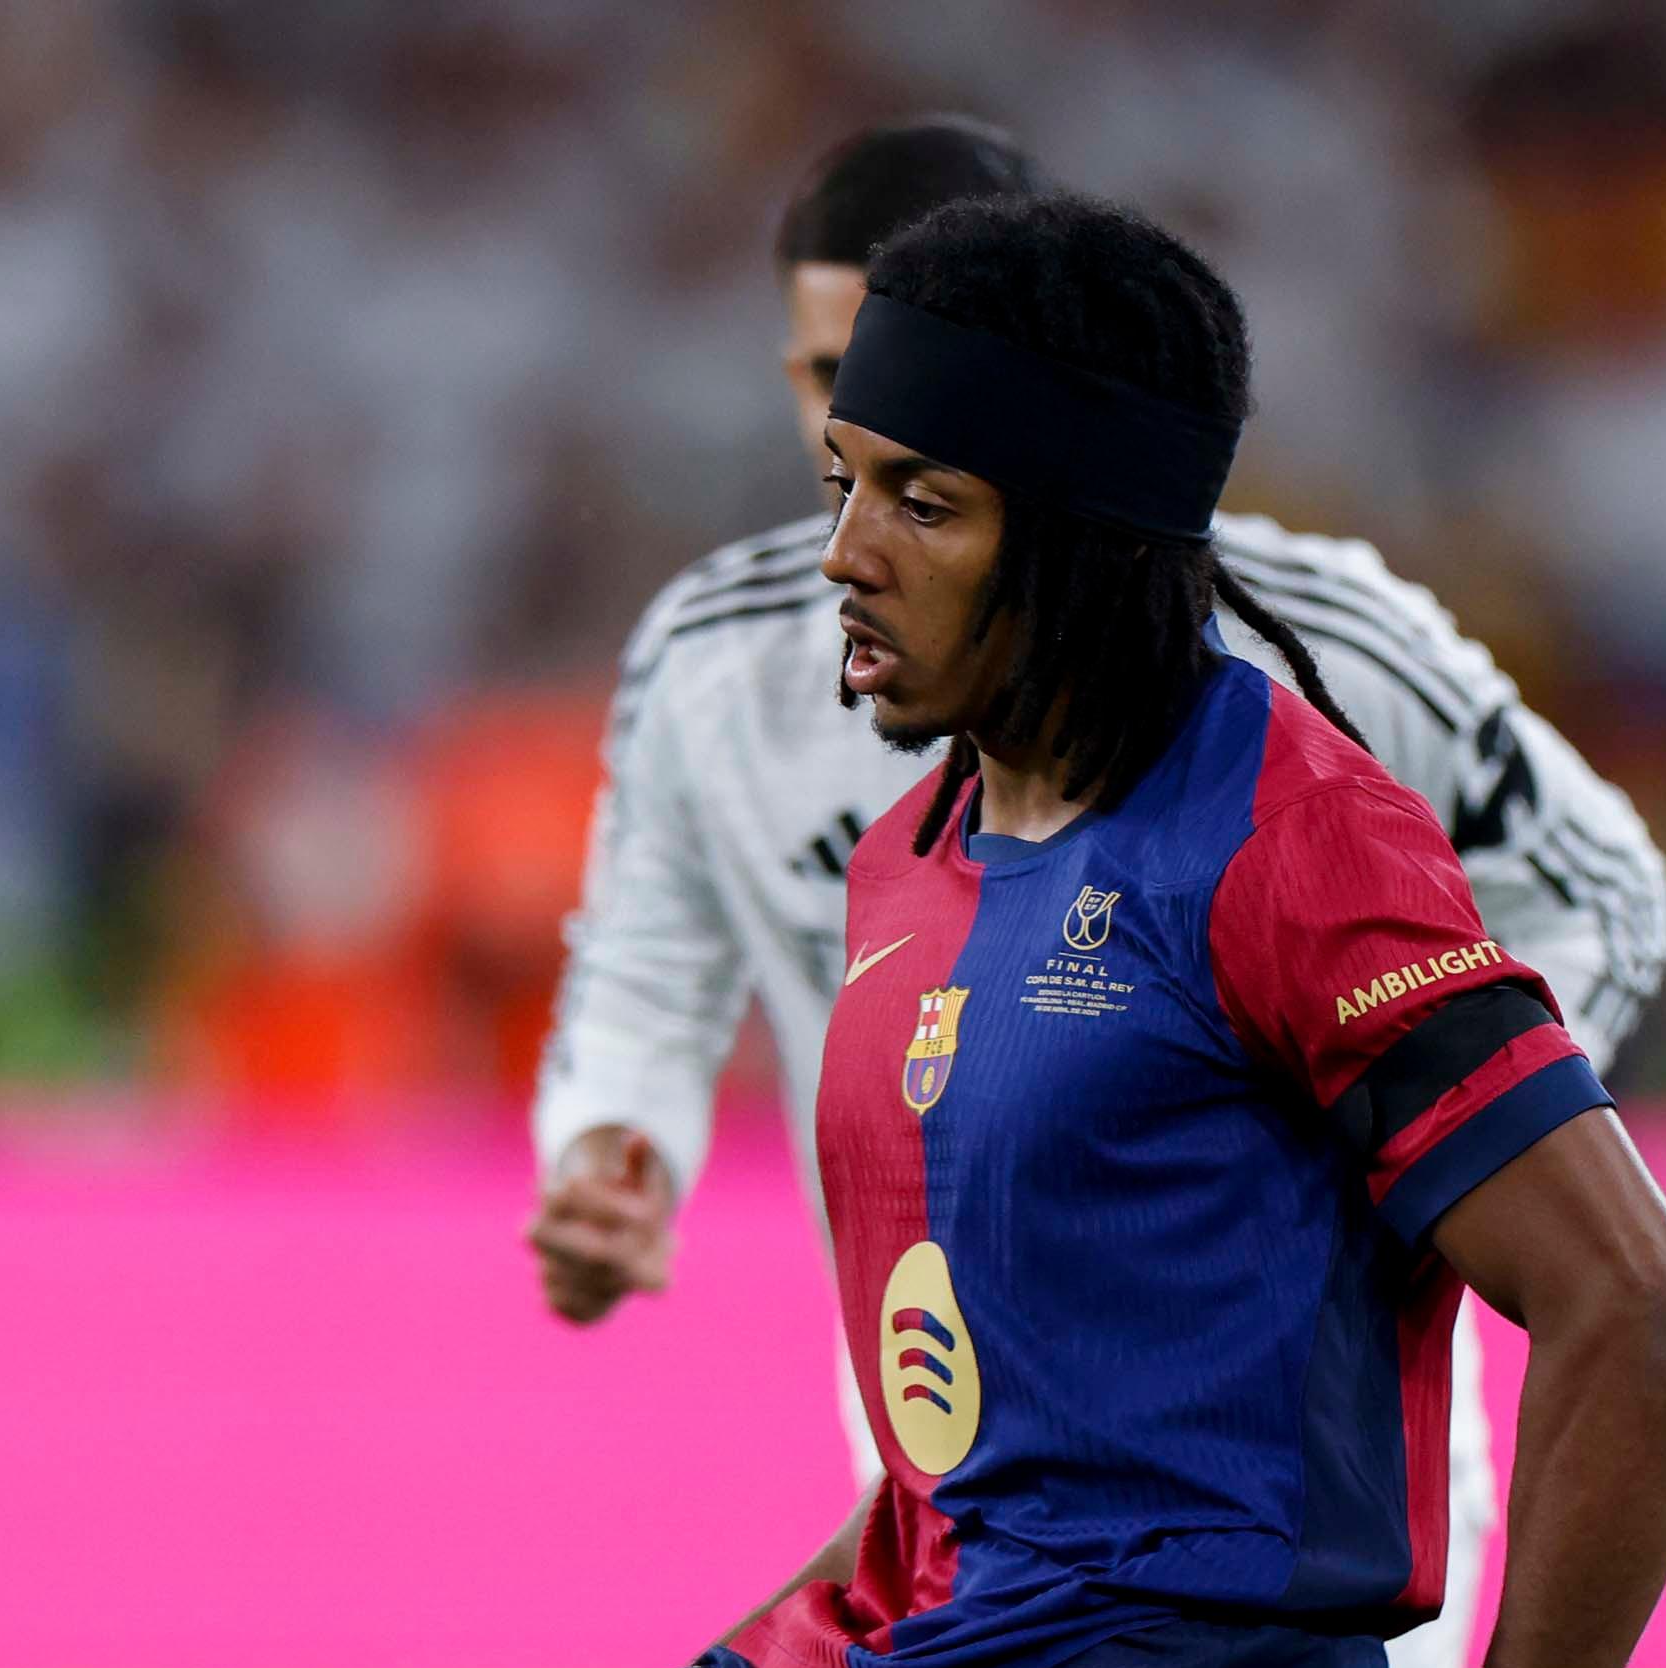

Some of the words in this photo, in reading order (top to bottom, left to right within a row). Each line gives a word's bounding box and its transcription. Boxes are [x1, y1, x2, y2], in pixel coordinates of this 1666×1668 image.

[1046, 959, 1109, 977] FINAL
[1049, 975, 1063, 985] DE
[1091, 980, 1107, 990] EL
[1108, 982, 1135, 993] REY
[1335, 940, 1504, 1025] AMBILIGHT
